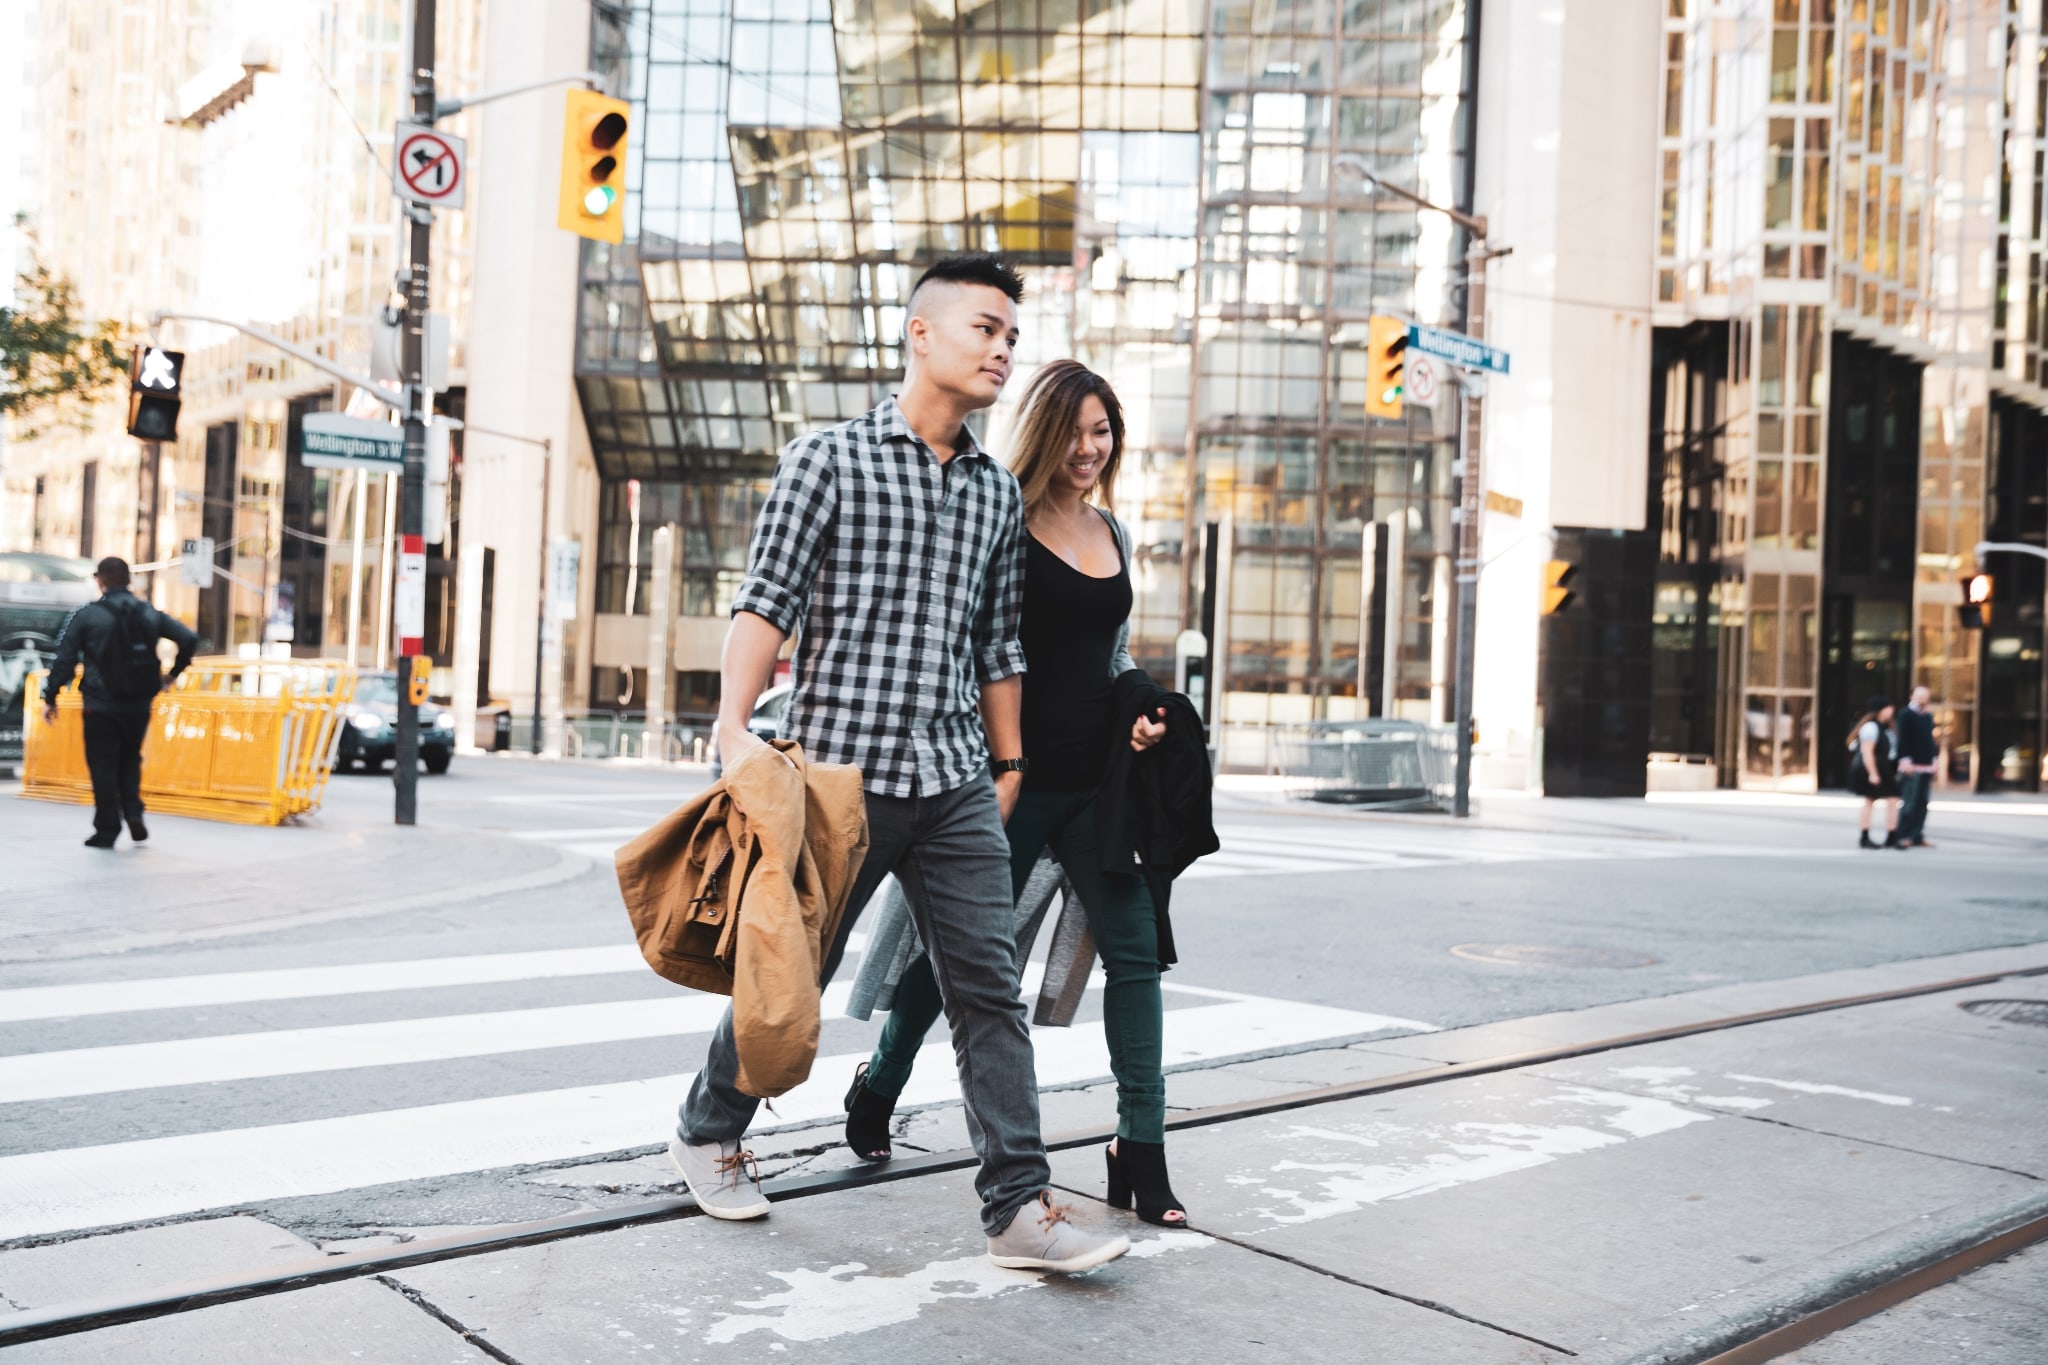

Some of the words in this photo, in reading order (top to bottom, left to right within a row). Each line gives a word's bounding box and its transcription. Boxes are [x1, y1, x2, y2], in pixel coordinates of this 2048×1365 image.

[1419, 328, 1482, 363] Wellington
[305, 432, 376, 458] Wellington
[389, 440, 403, 459] W
